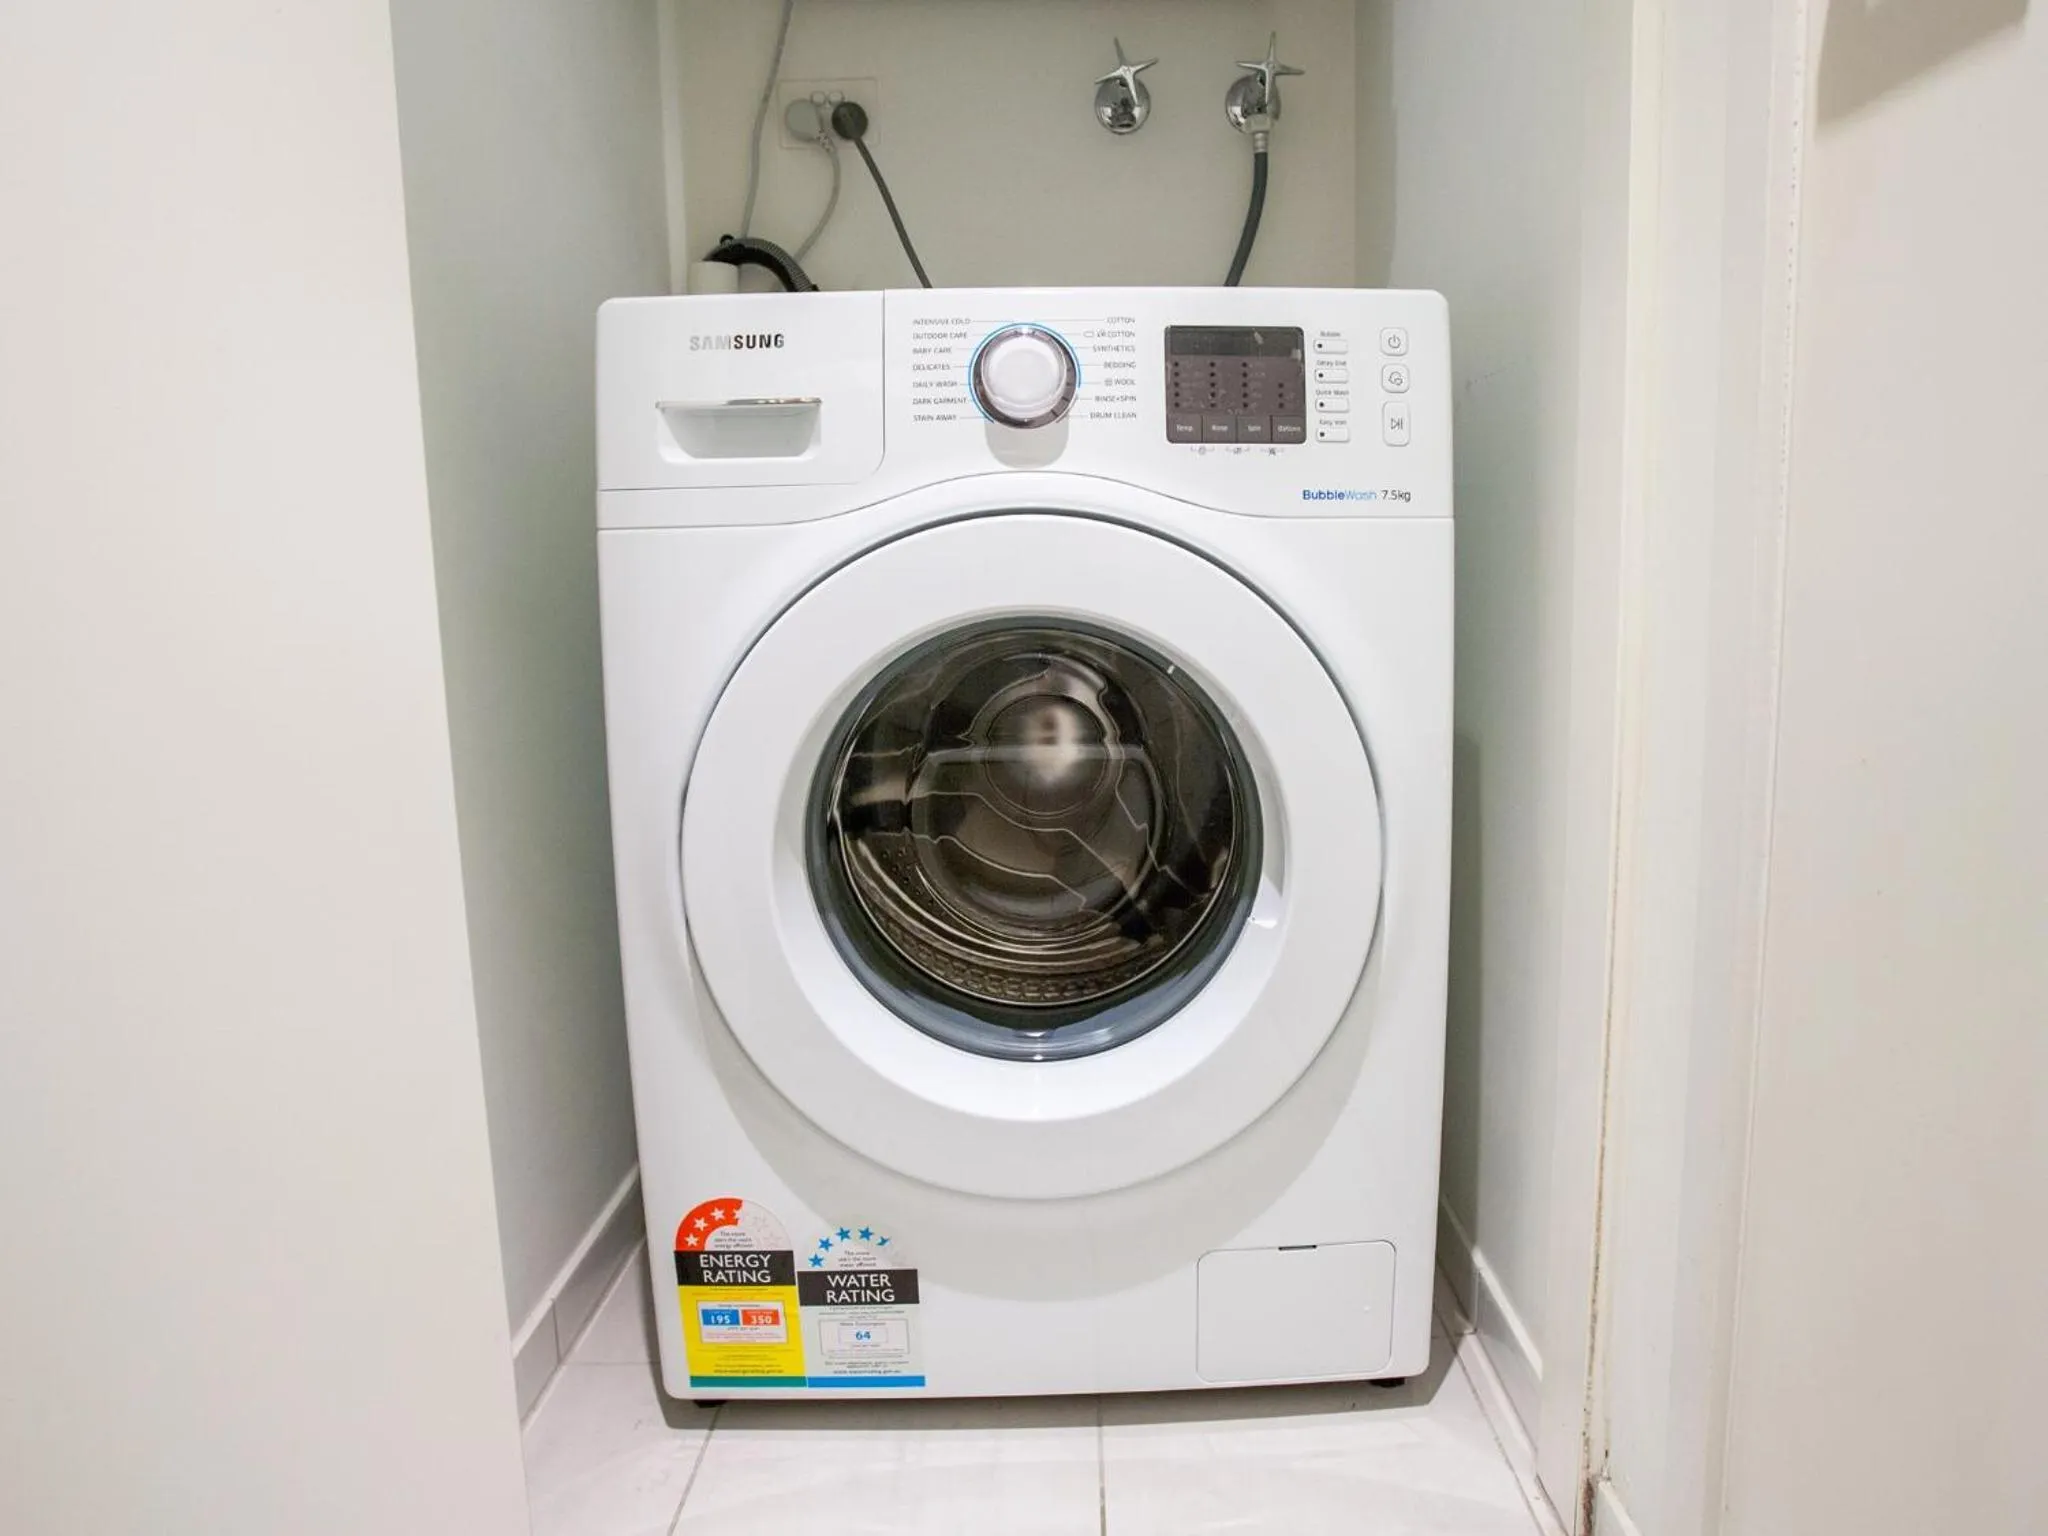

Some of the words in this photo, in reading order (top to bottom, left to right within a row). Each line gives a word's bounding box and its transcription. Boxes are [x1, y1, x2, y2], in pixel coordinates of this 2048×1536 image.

[690, 333, 785, 351] SAMSUNG
[1302, 488, 1377, 500] BubbleWash
[1380, 489, 1411, 502] 7.5kg
[700, 1254, 772, 1268] ENERGY
[703, 1270, 772, 1283] RATING
[827, 1274, 892, 1288] WATER
[826, 1289, 895, 1304] RATING
[710, 1314, 731, 1324] 195
[751, 1315, 772, 1324] 350
[855, 1330, 872, 1341] 64
